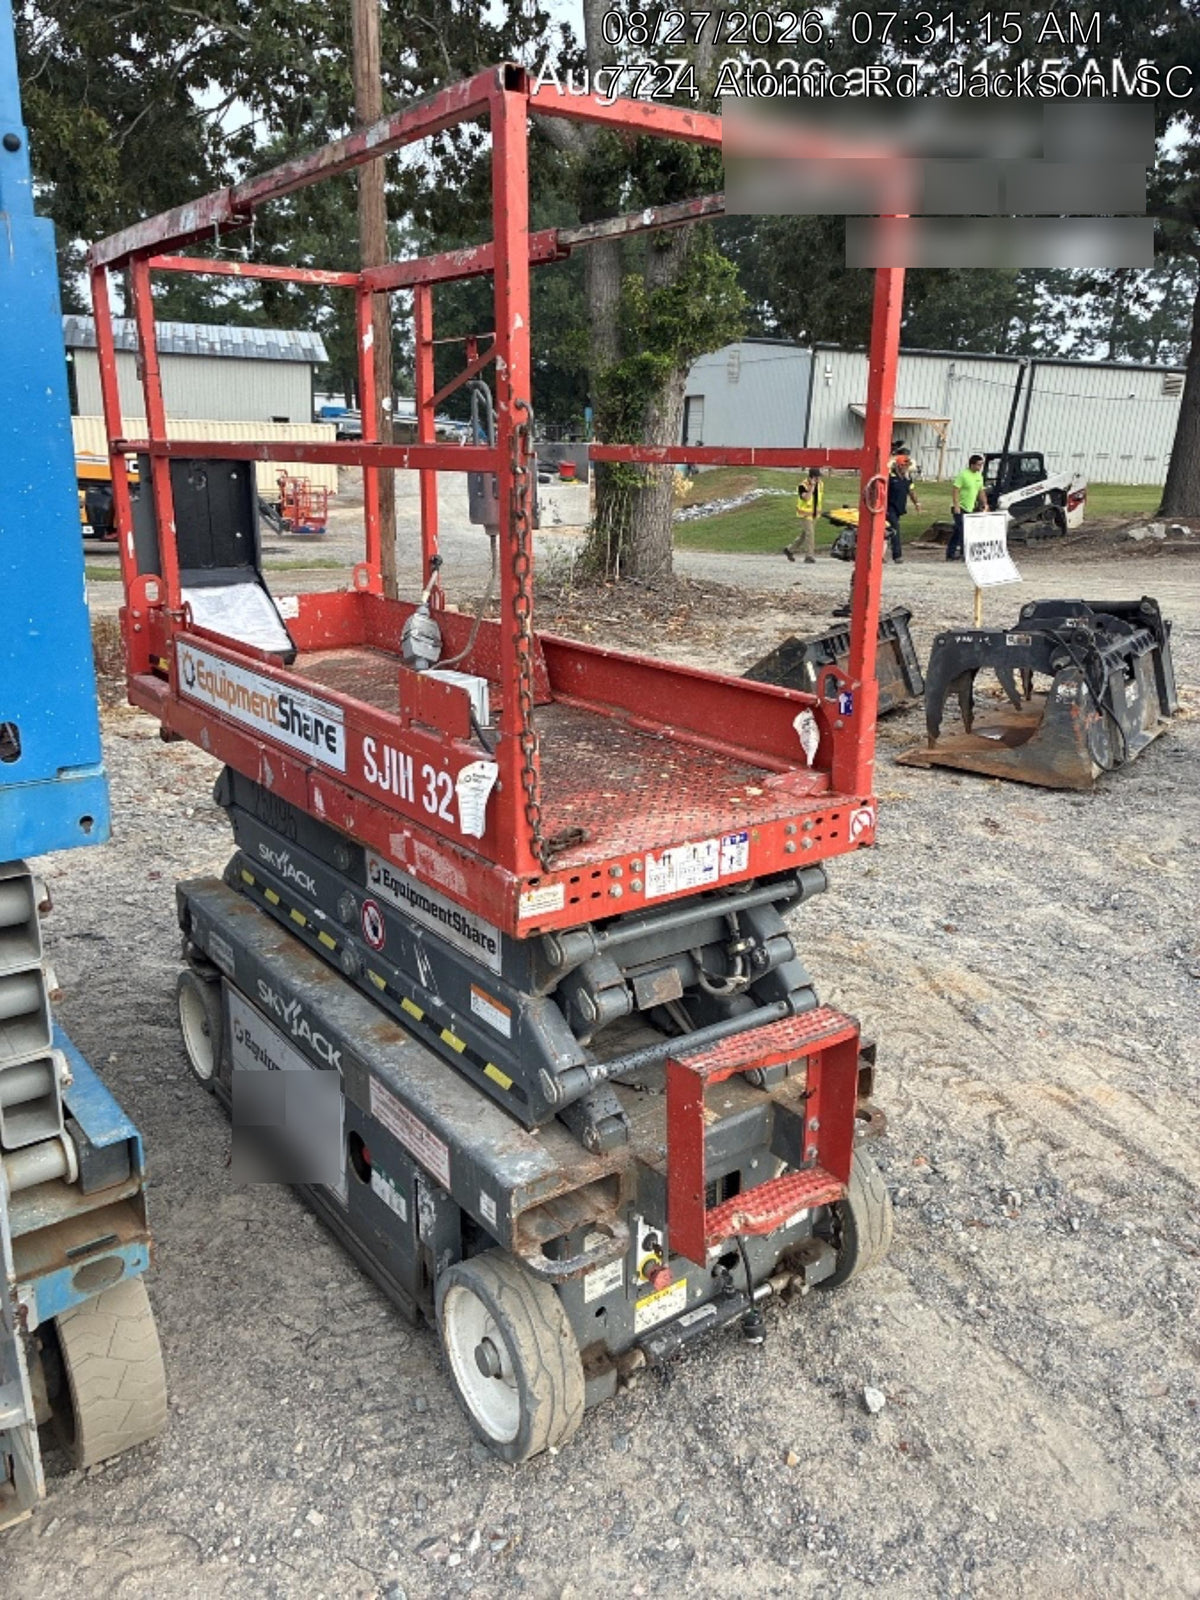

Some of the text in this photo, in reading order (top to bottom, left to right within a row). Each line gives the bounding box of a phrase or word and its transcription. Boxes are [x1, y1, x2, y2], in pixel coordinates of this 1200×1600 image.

[197, 659, 337, 755] EquipmentShare
[421, 763, 456, 824] 32
[258, 843, 318, 897] SKYJACK
[382, 867, 498, 956] EquipmentShare
[257, 978, 344, 1077] SKYJACK
